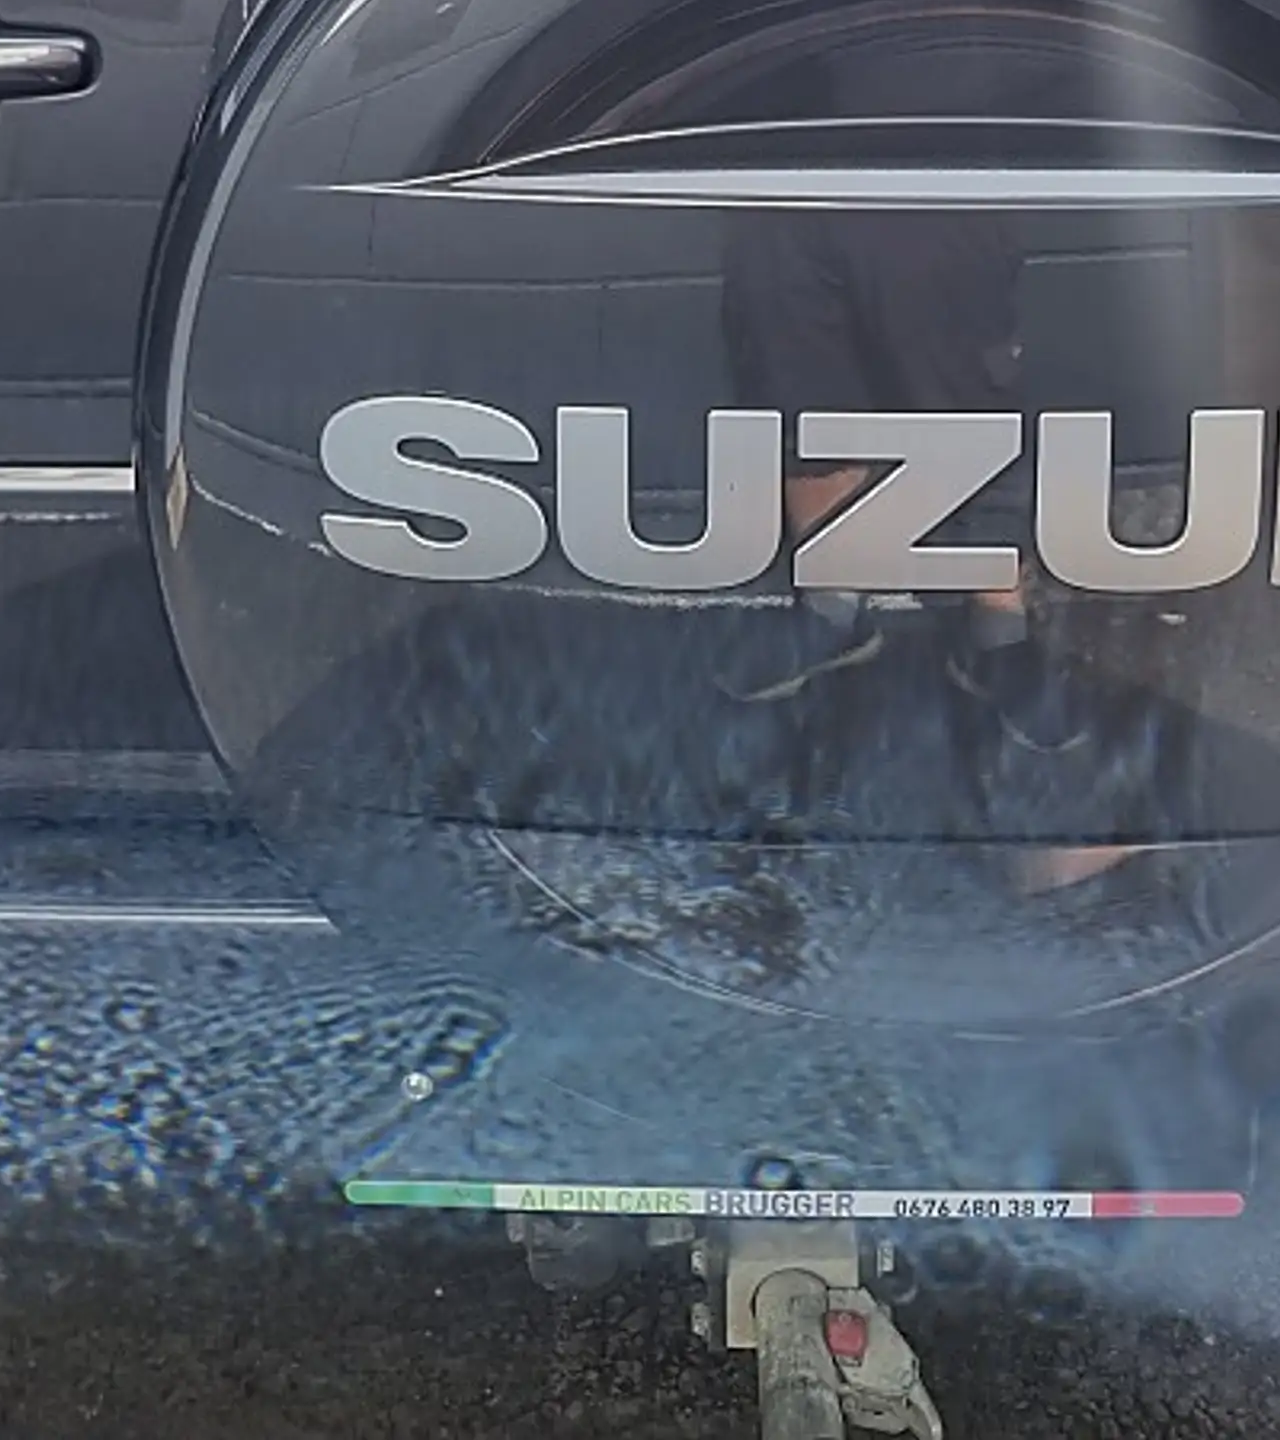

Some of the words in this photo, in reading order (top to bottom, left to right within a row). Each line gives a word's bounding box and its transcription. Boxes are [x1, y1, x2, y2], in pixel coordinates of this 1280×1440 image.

[520, 1187, 607, 1212] ALPIN
[617, 1190, 693, 1213] CARS
[704, 1191, 856, 1217] BRUGGER
[894, 1198, 950, 1218] 0676
[957, 1198, 1001, 1218] 480
[1007, 1198, 1036, 1218] 38
[1042, 1198, 1071, 1218] 97
